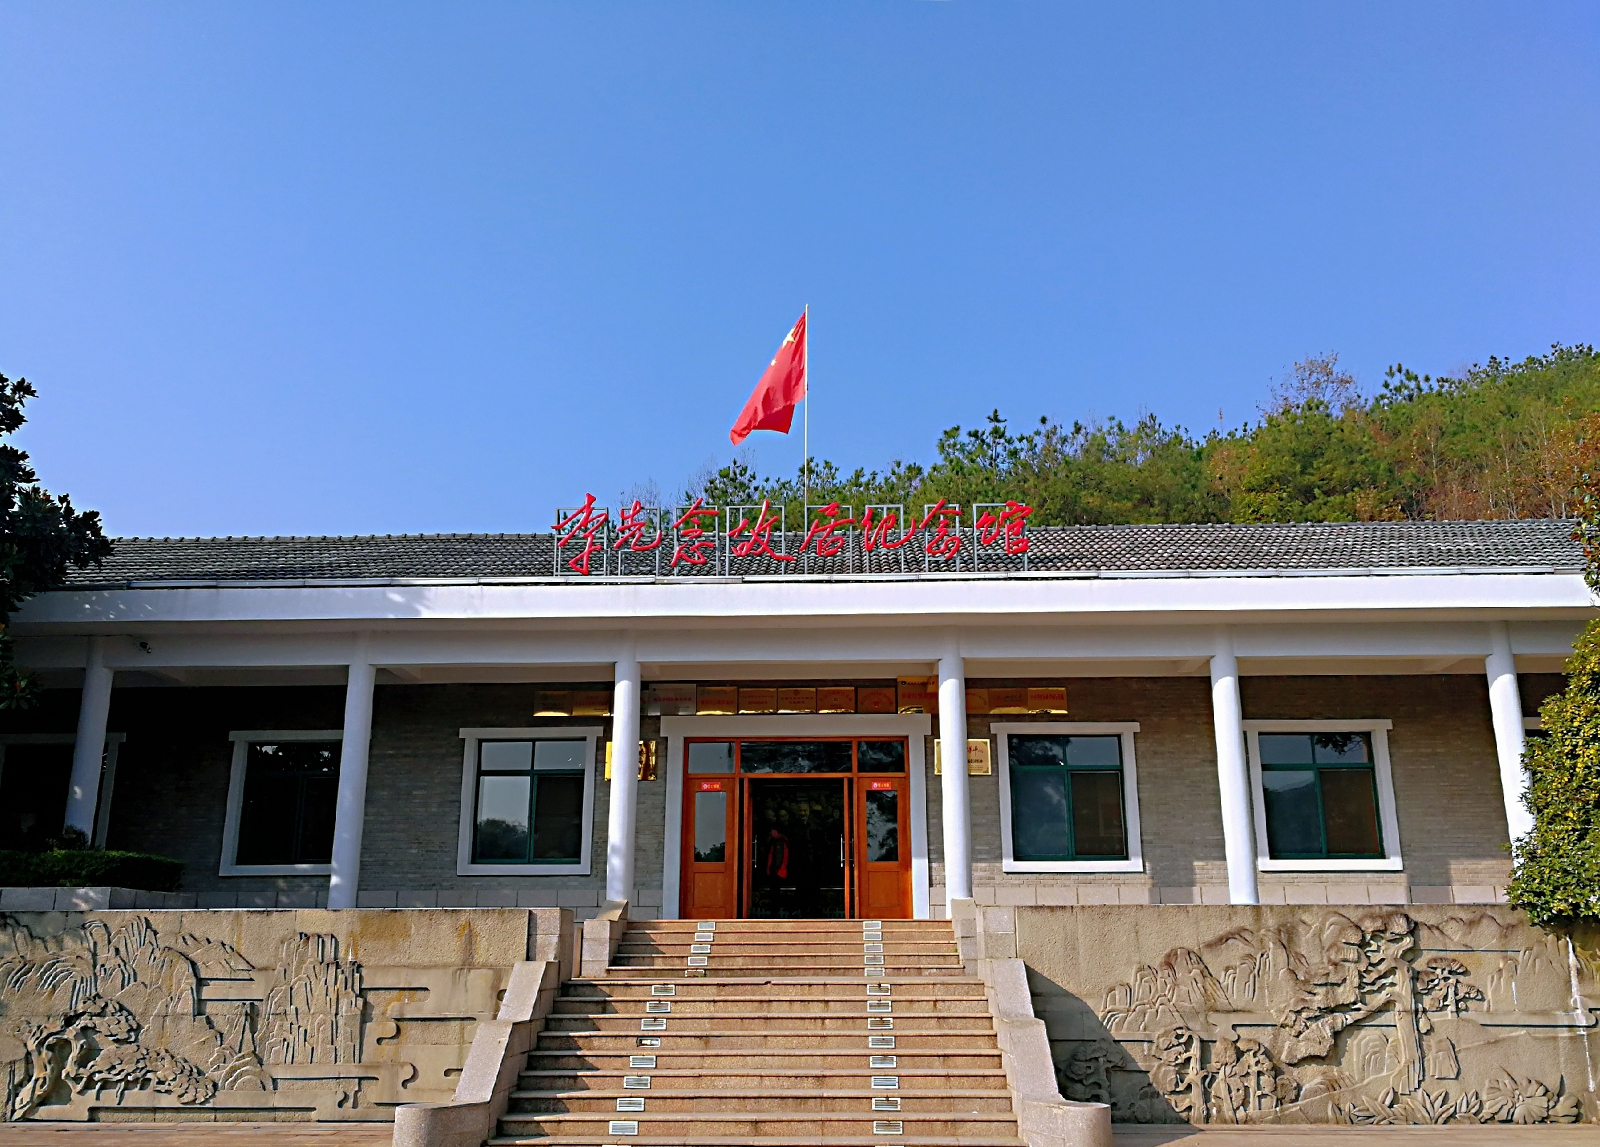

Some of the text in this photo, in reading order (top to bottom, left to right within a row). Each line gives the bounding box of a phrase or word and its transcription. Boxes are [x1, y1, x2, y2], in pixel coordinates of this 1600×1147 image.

[551, 494, 1033, 574] 李先念故居纪念馆
